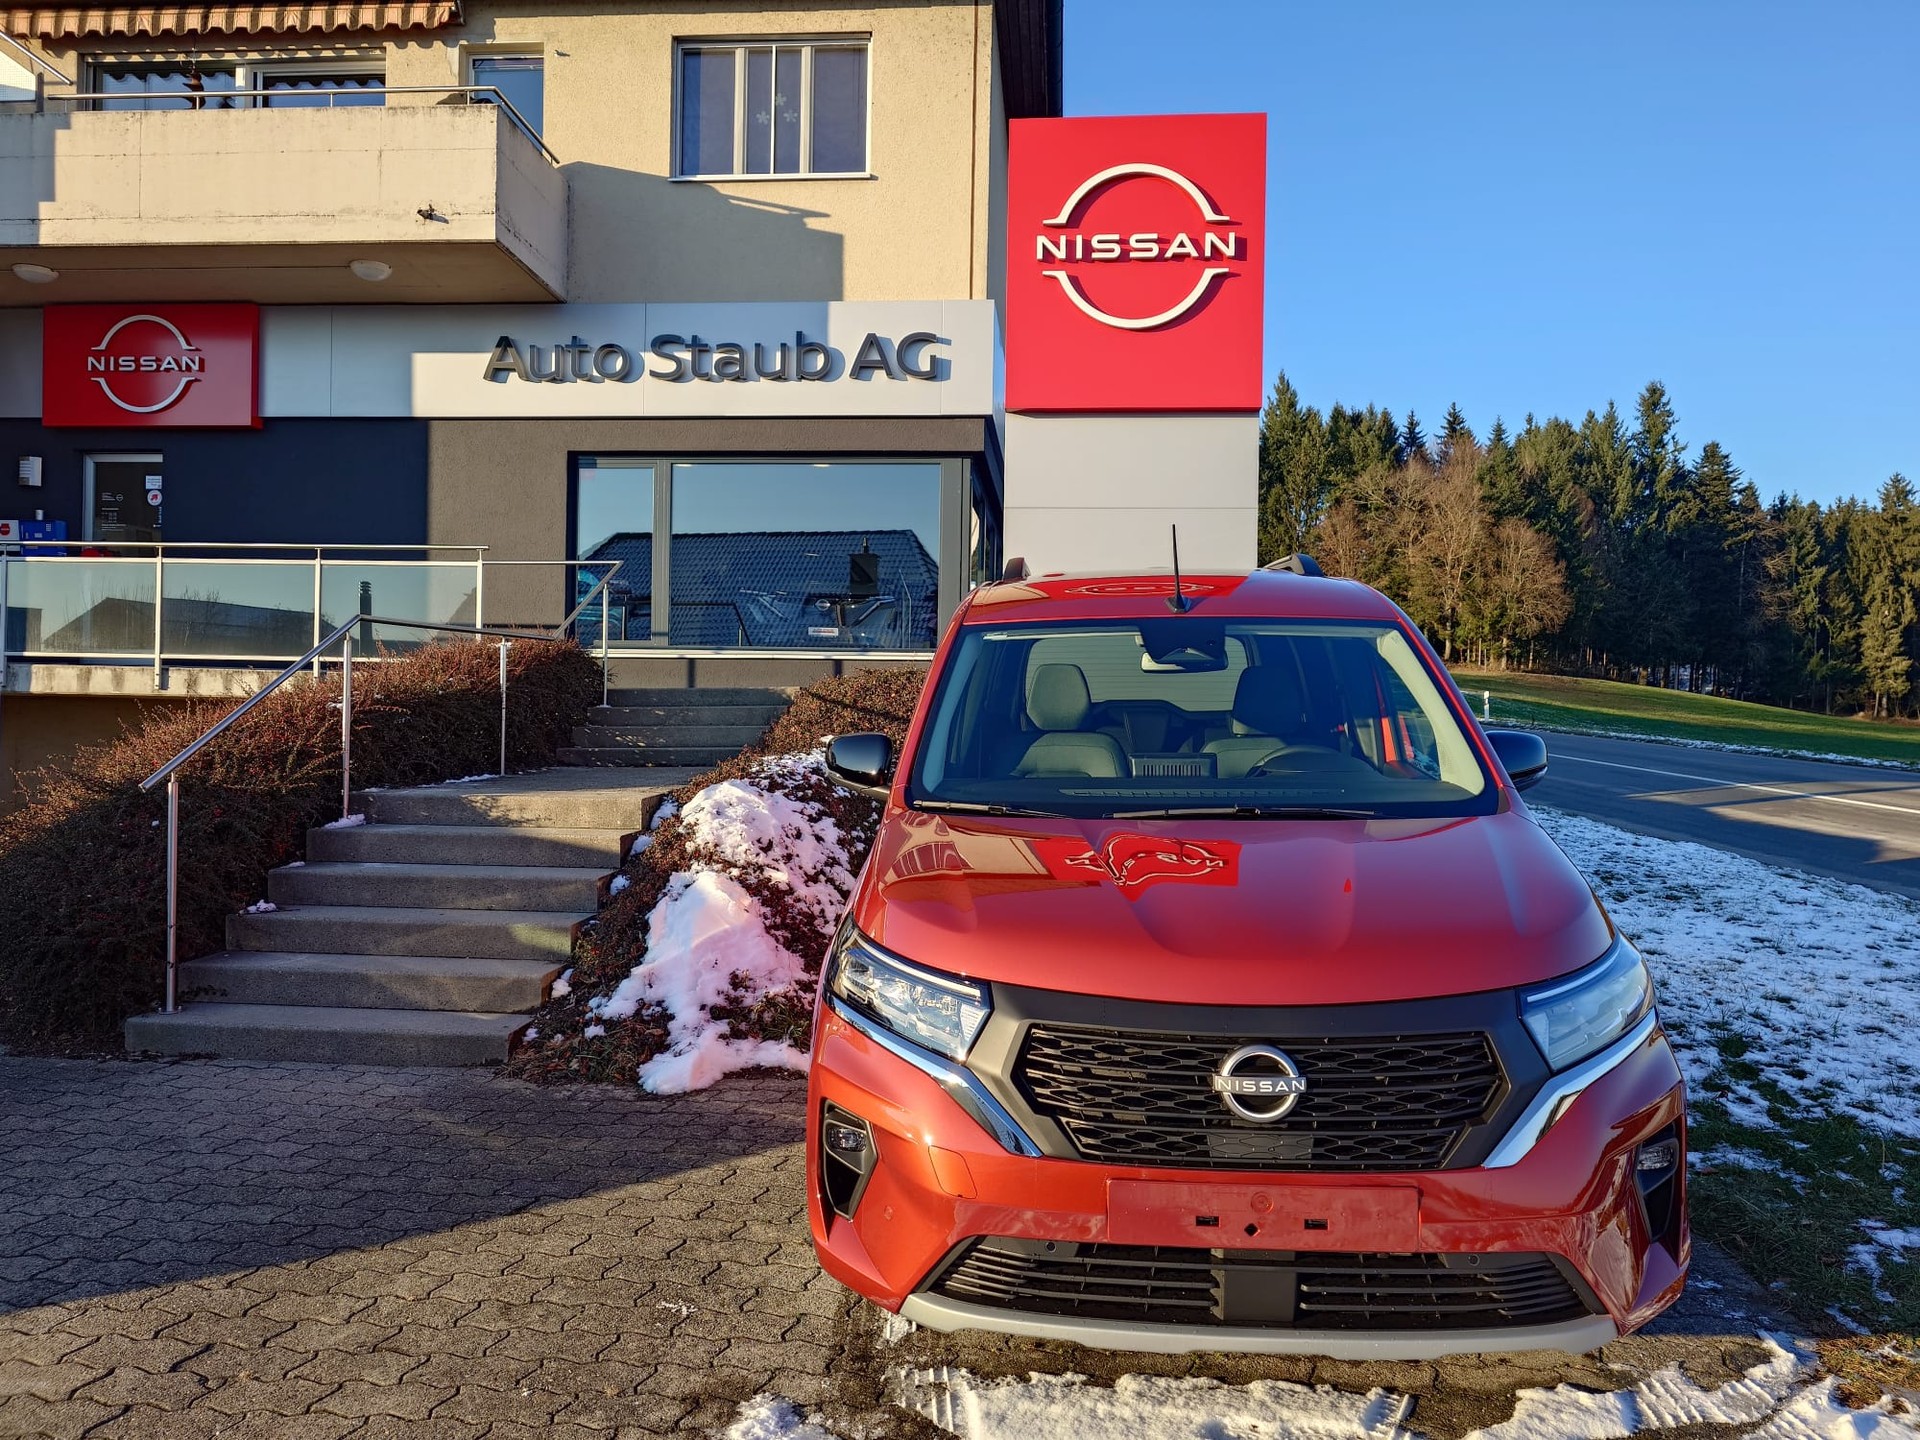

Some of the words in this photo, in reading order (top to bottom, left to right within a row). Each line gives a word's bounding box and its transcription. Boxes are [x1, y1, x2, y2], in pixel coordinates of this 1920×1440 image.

[1036, 231, 1237, 260] NISSAN
[87, 355, 200, 372] NISSAN
[483, 335, 630, 382] Auto
[649, 331, 833, 381] Staub
[849, 331, 937, 380] AG
[1216, 1078, 1305, 1093] NISSAN
